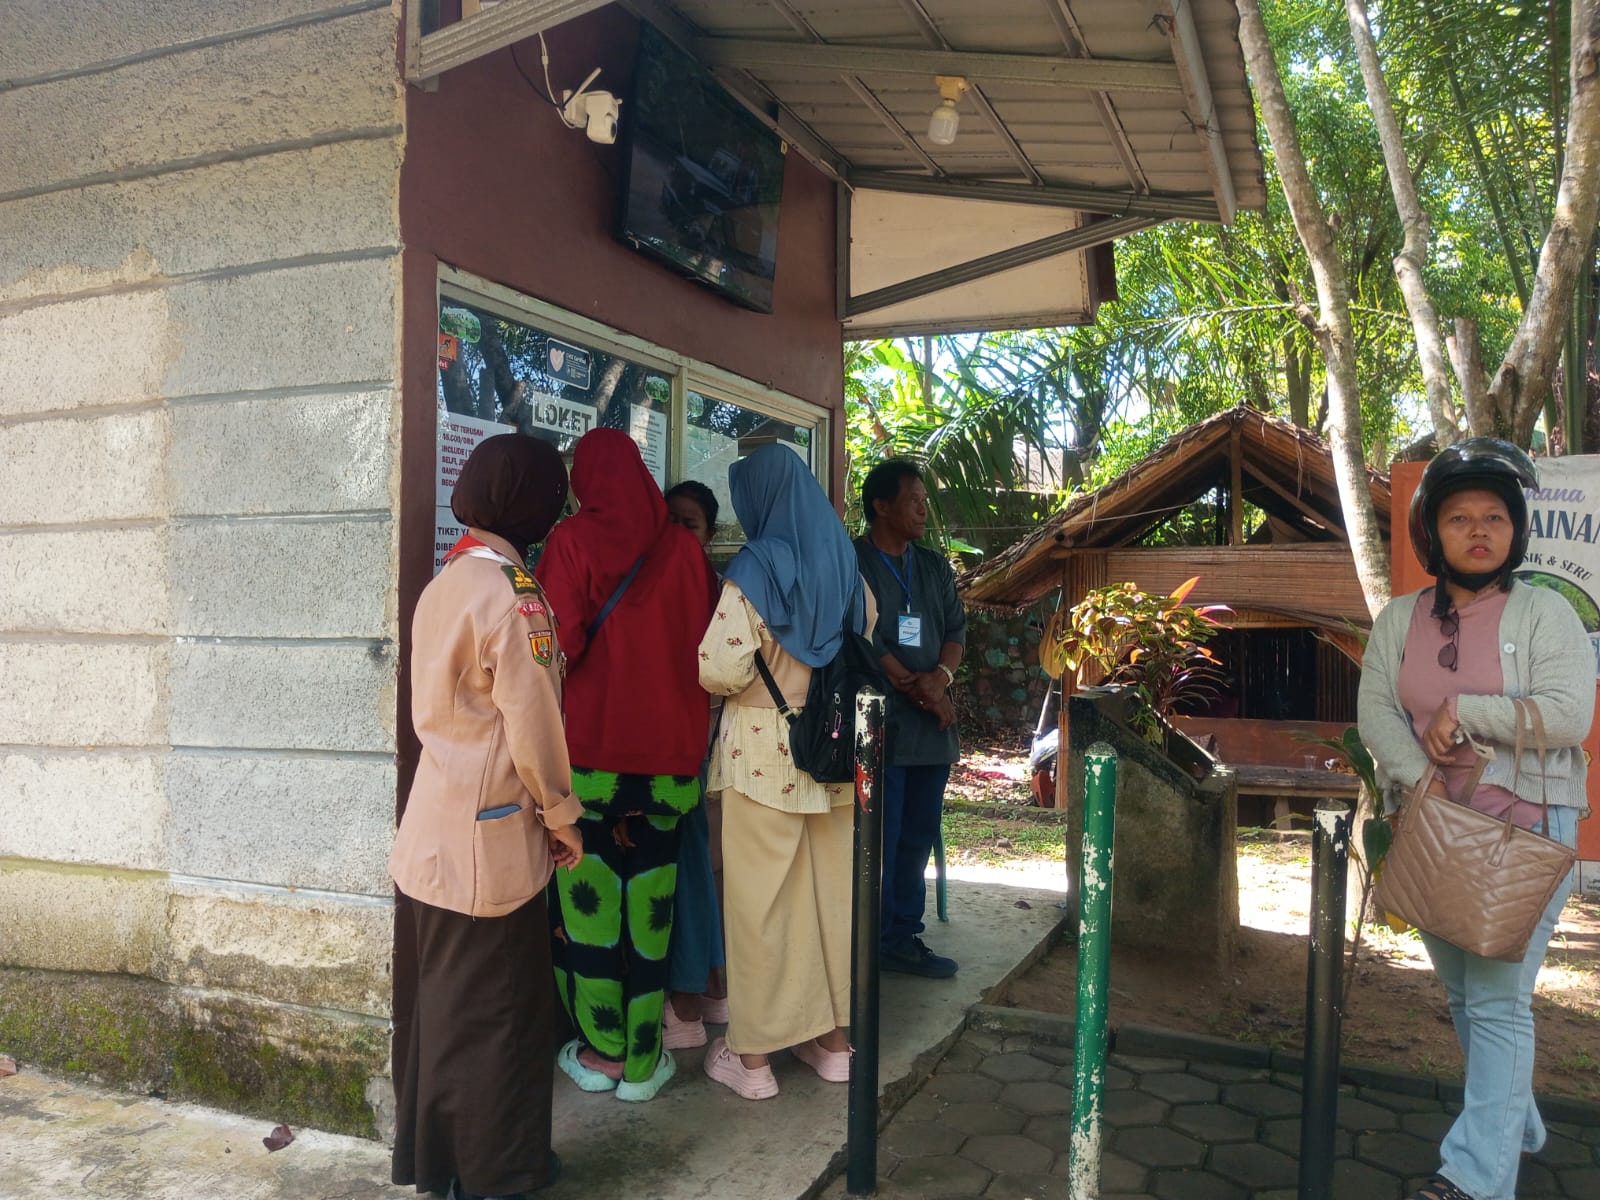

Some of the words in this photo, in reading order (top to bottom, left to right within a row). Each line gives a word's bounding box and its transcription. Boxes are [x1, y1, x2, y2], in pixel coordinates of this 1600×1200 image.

[534, 402, 592, 433] LOKET
[442, 445, 465, 456] INCLUDE
[437, 526, 459, 536] TIKET
[1528, 509, 1600, 544] AINA
[1547, 555, 1558, 566] &
[1560, 559, 1593, 581] SERU
